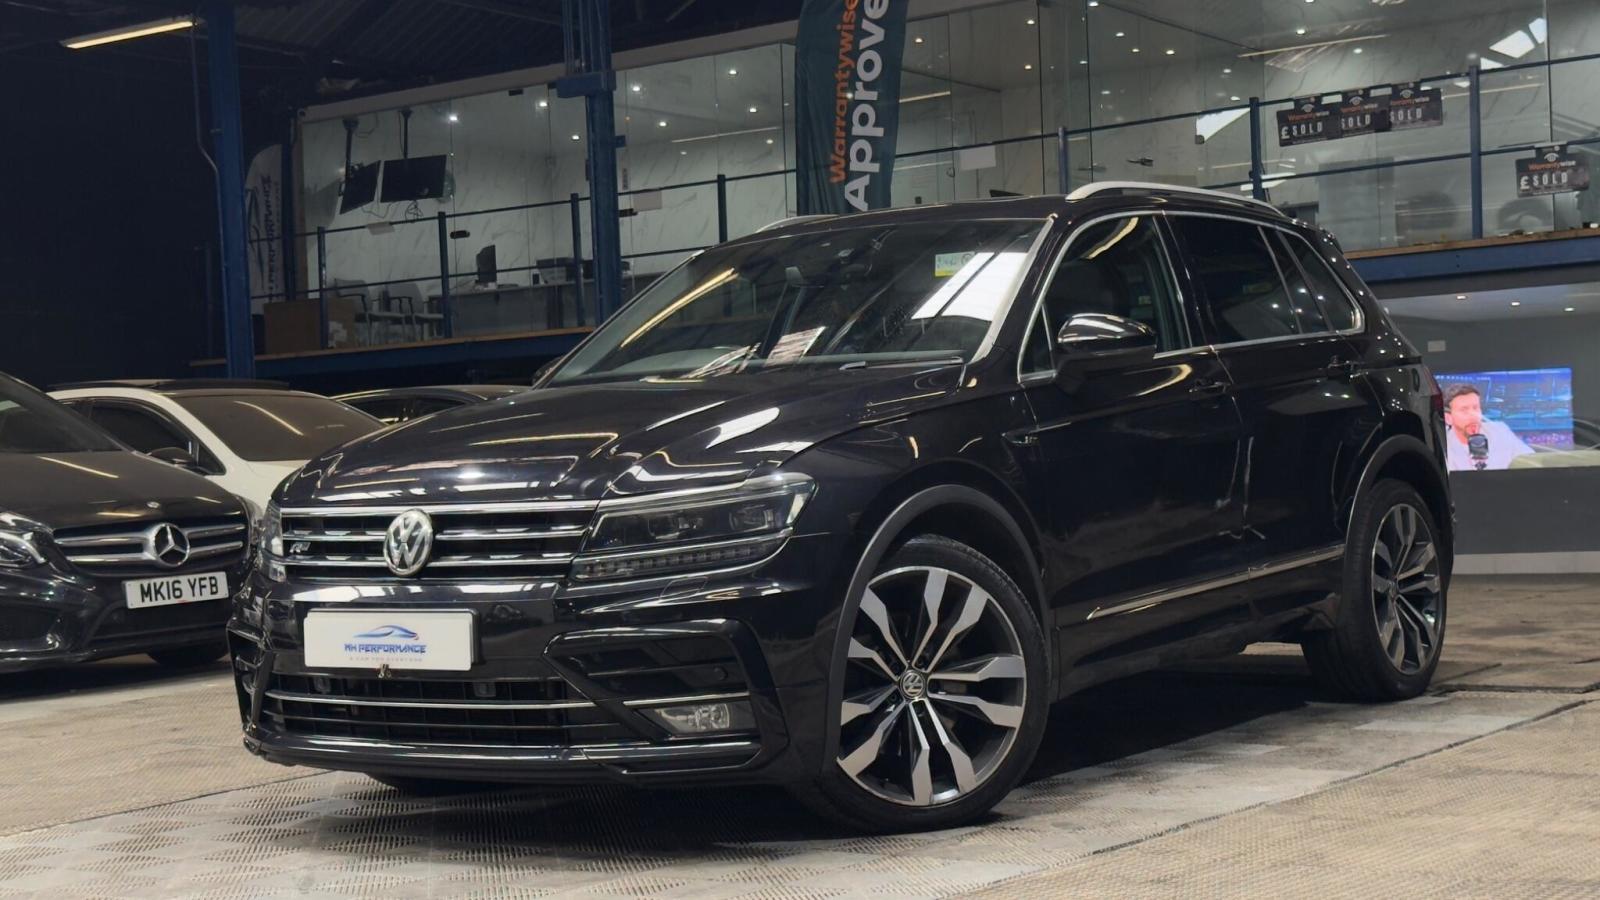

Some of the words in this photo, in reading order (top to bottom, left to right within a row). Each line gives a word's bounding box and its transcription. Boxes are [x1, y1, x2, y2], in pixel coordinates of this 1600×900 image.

[829, 0, 859, 184] Warrantywise
[140, 580, 183, 603] MK16
[187, 575, 219, 598] YFB
[358, 644, 426, 654] PERFORMANCE
